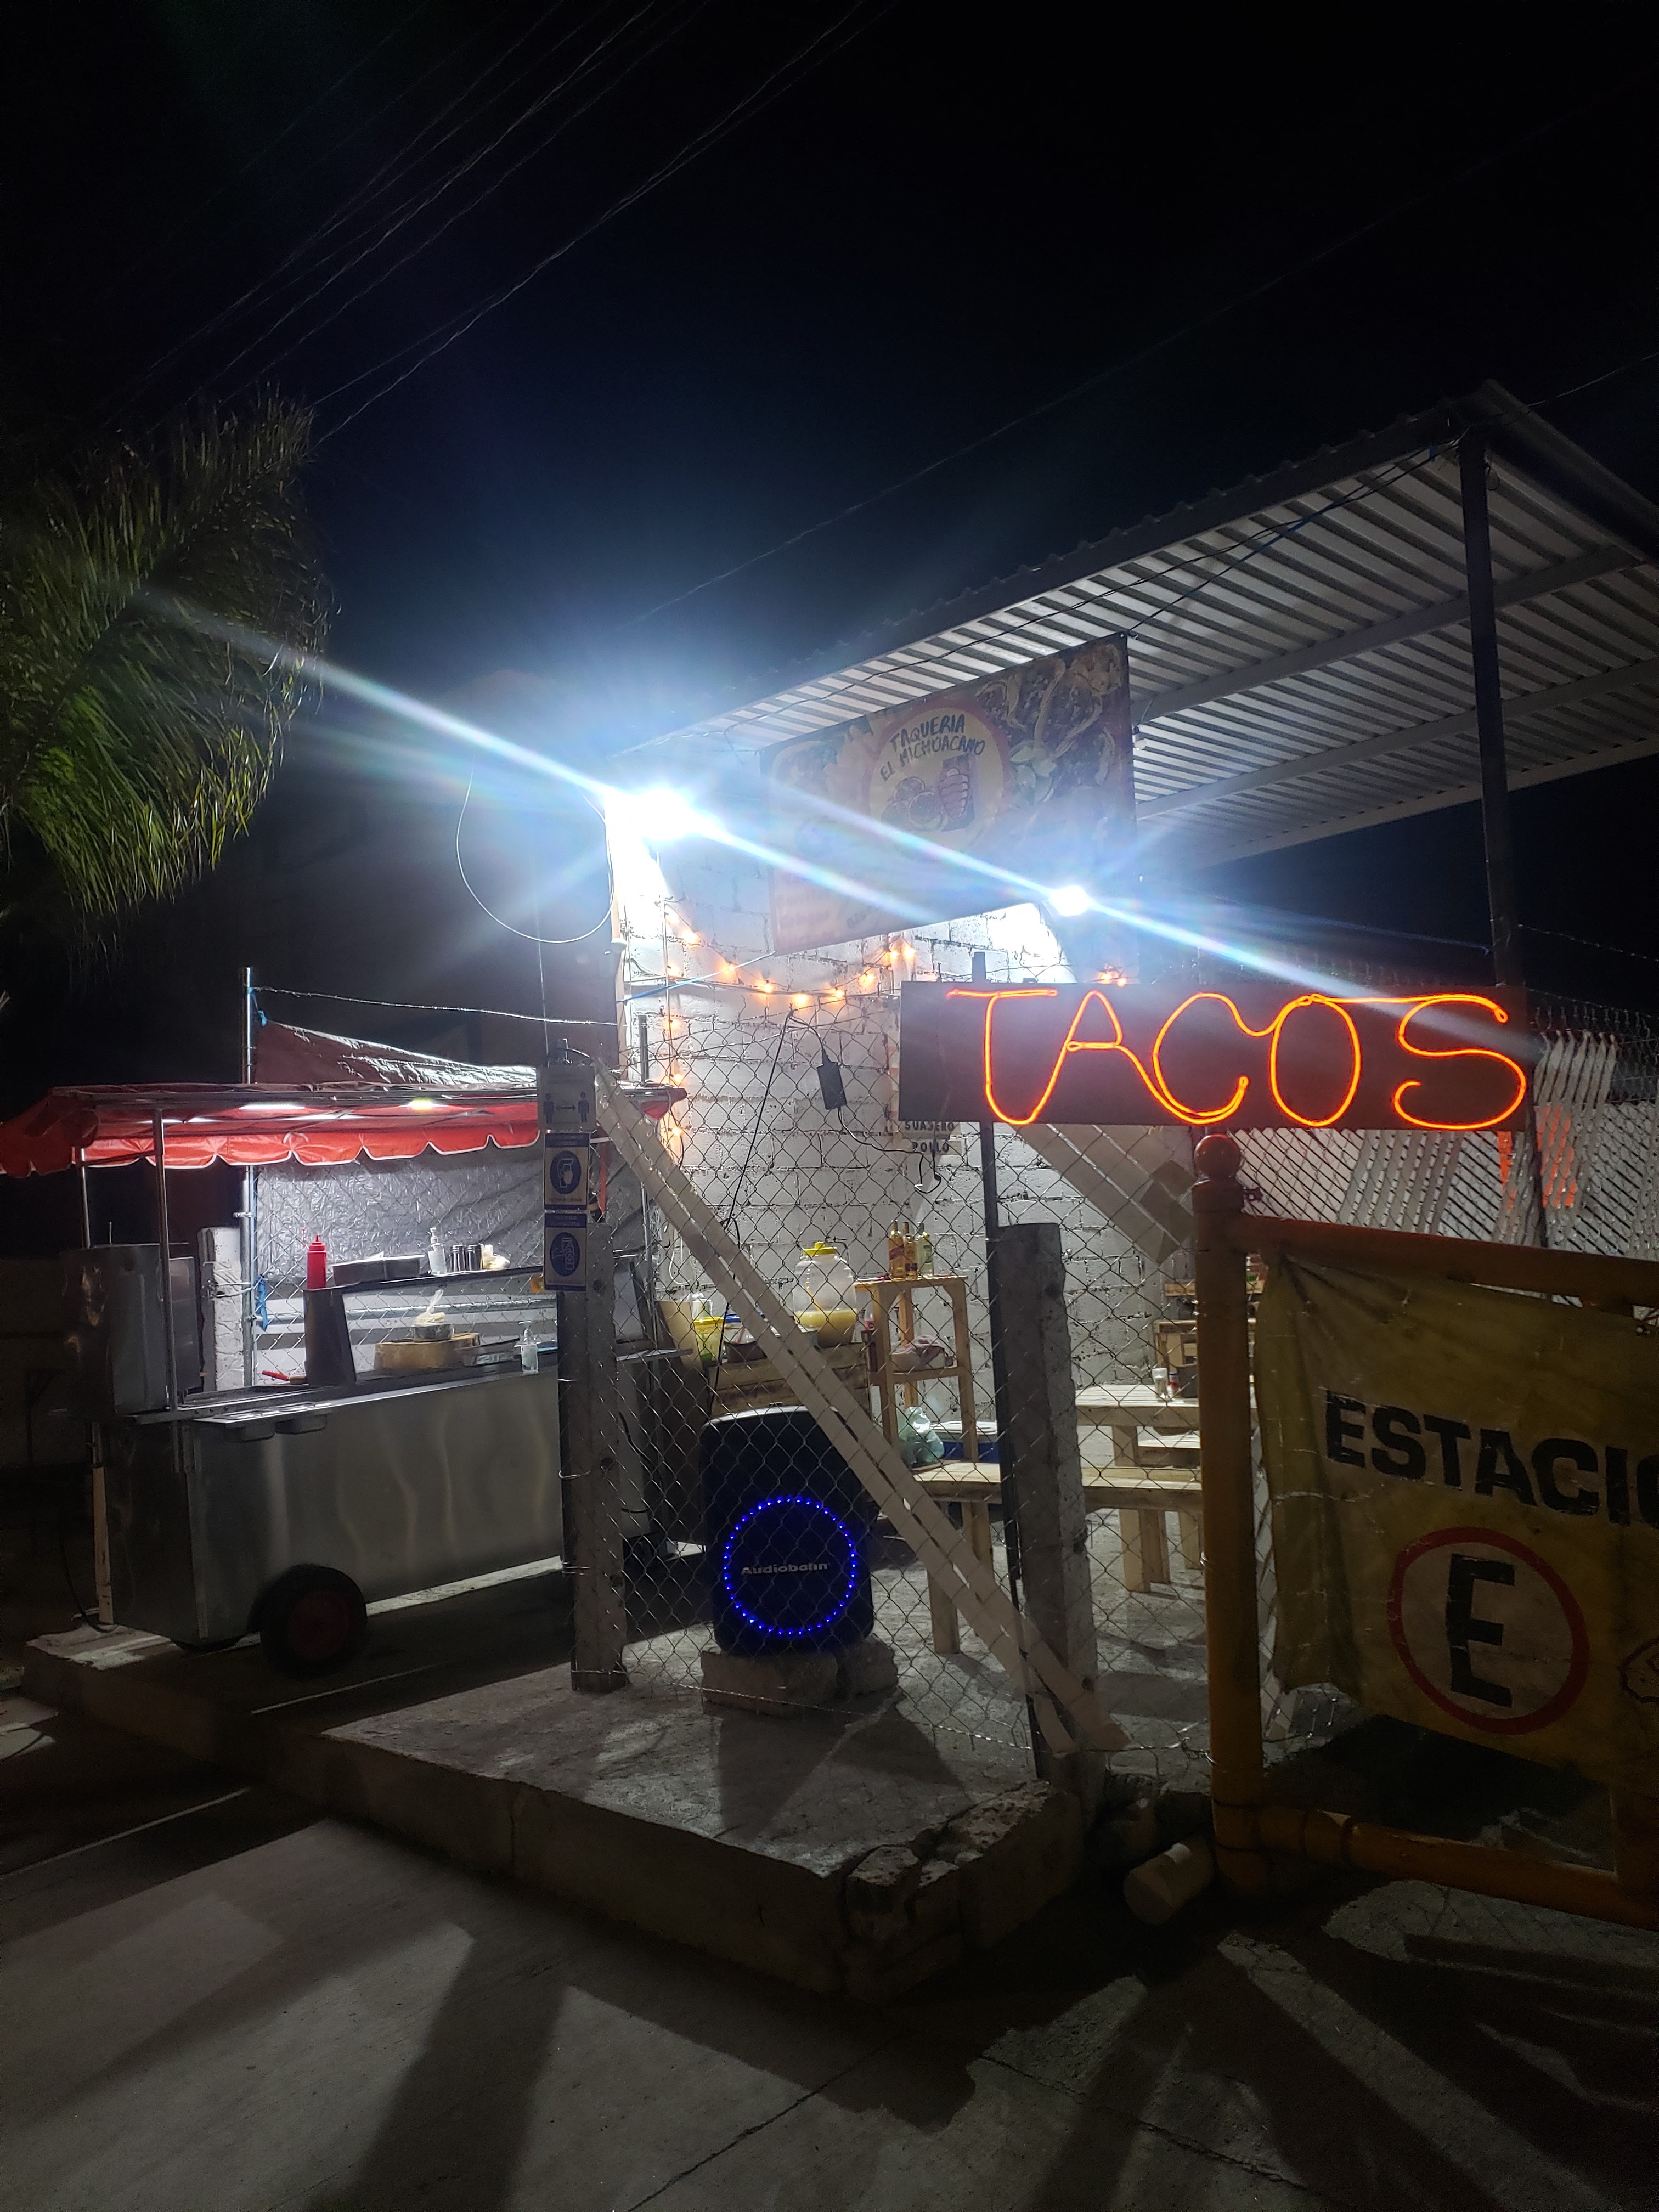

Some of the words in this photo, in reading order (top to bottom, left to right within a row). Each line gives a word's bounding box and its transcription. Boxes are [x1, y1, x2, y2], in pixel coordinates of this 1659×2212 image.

[889, 714, 965, 752] TAQUERIA
[880, 761, 895, 781] EL
[899, 735, 985, 768] MICHOACANO
[947, 989, 1527, 1130] TACOS
[912, 1142, 950, 1153] POLLO
[742, 1562, 828, 1575] Audiobahn
[1444, 1553, 1516, 1708] E
